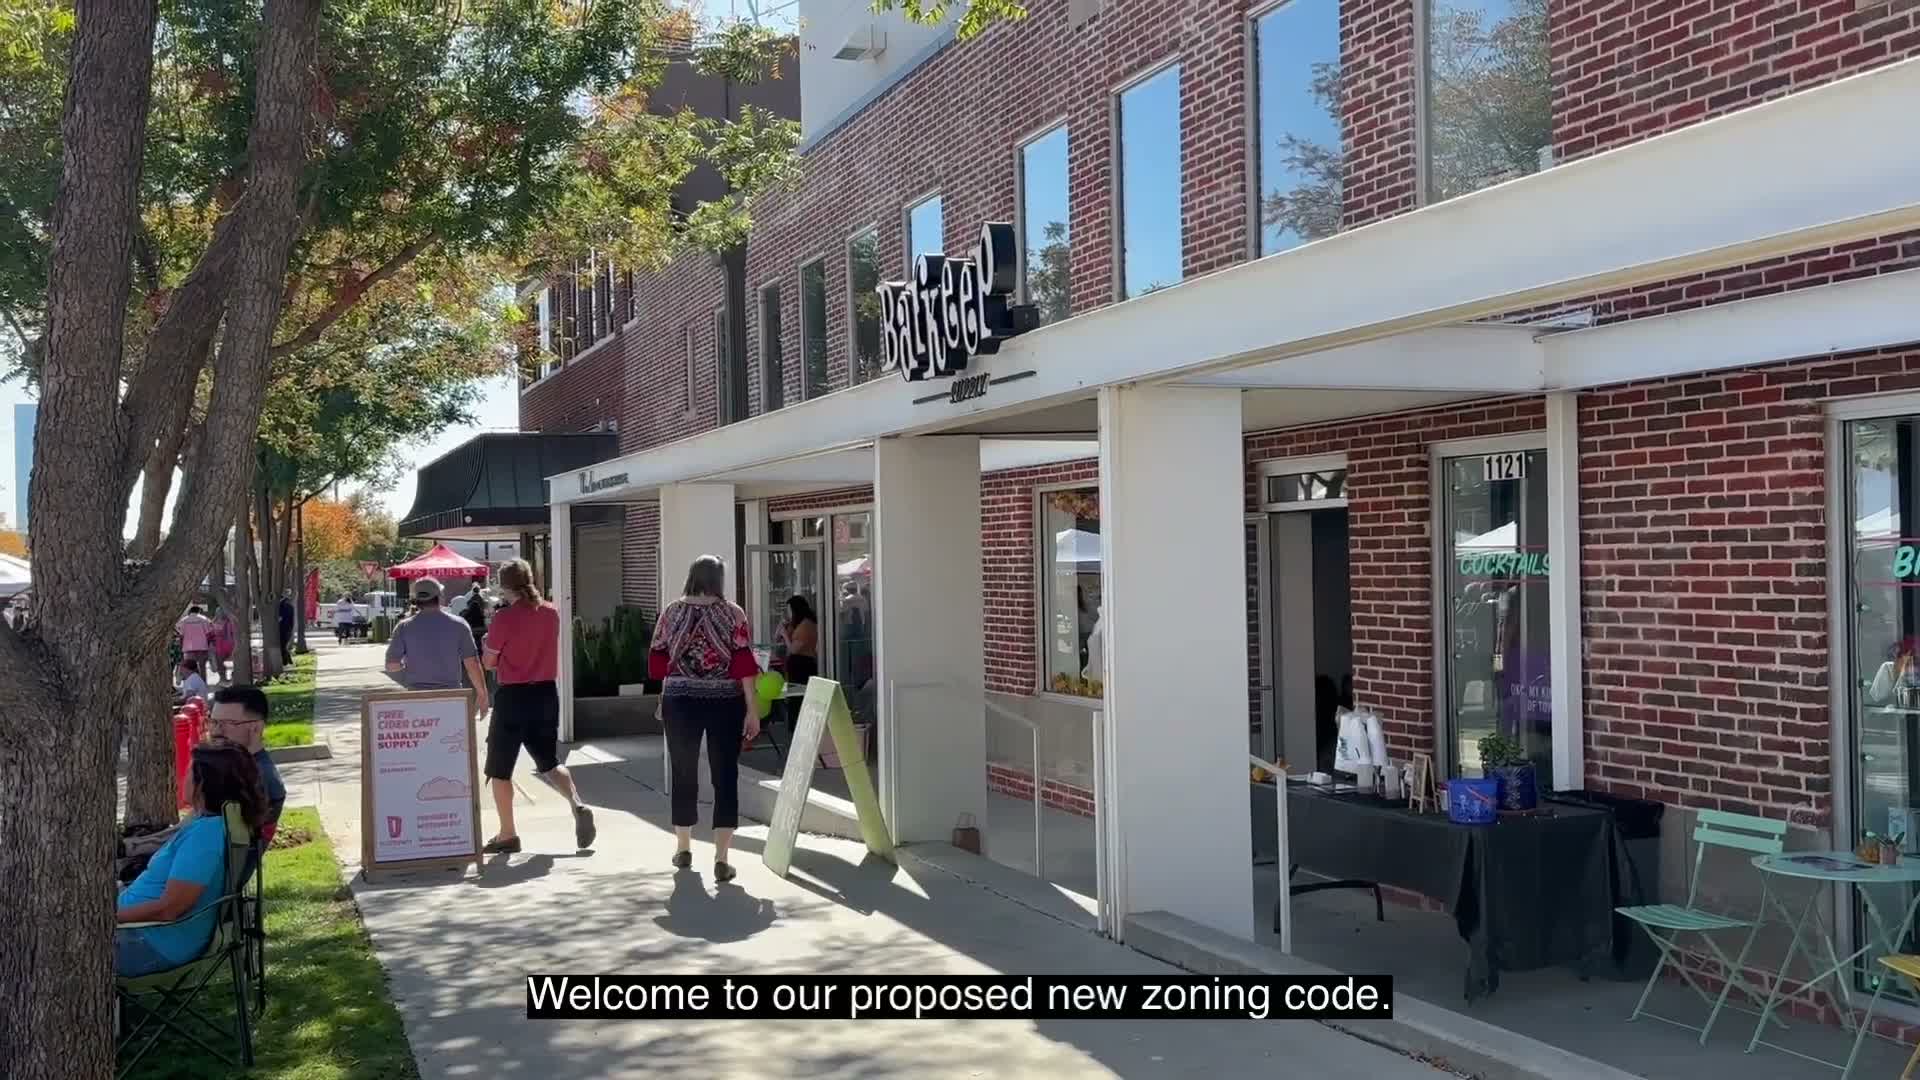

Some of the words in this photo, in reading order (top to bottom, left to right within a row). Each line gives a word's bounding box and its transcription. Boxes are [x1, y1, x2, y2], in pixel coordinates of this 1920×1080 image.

[1486, 454, 1524, 479] 1121
[1460, 552, 1551, 578] COCKTAILS
[378, 710, 404, 720] FREE
[378, 720, 409, 730] CIDER
[412, 718, 440, 729] CART
[378, 731, 430, 741] BARKEEP
[378, 740, 419, 750] SUPPLY
